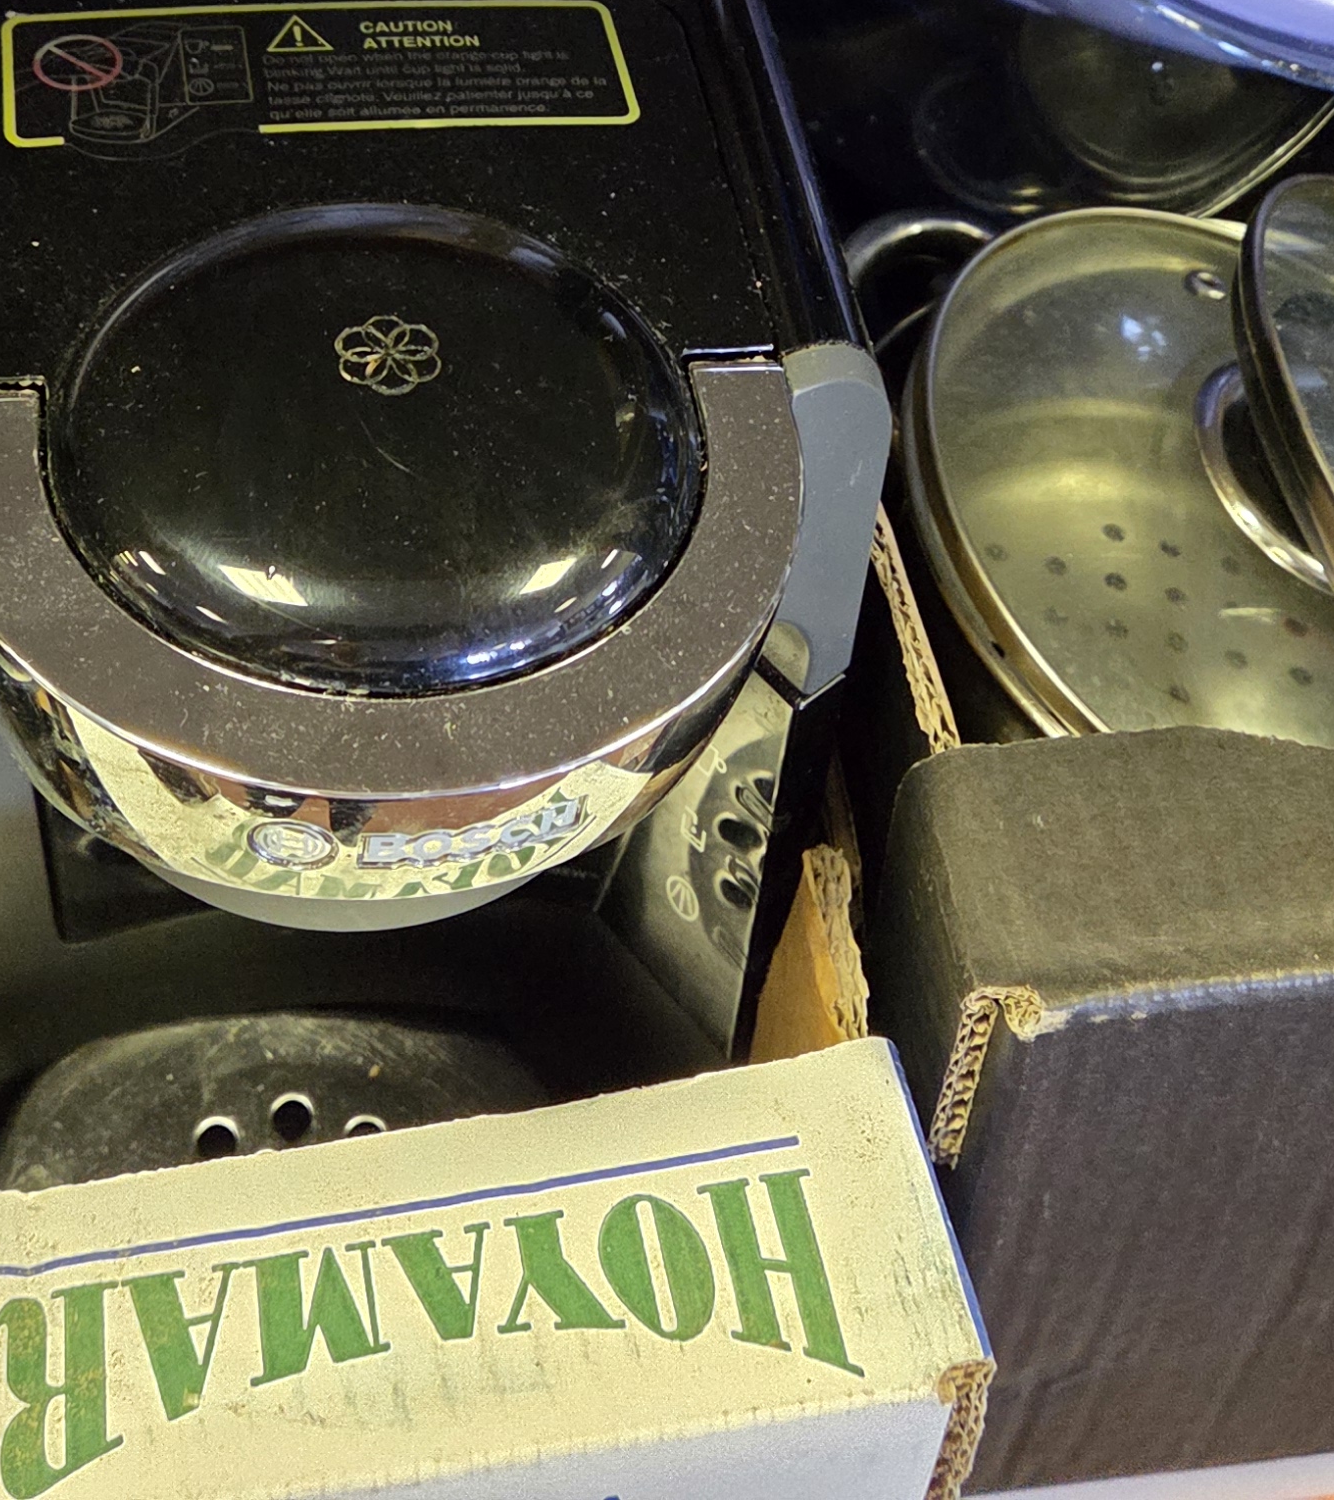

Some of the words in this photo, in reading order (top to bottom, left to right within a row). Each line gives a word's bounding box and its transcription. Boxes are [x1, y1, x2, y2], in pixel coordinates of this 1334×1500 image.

[359, 20, 453, 34] CAUTION
[363, 35, 480, 49] ATTENTION
[363, 800, 580, 864] BOSCH
